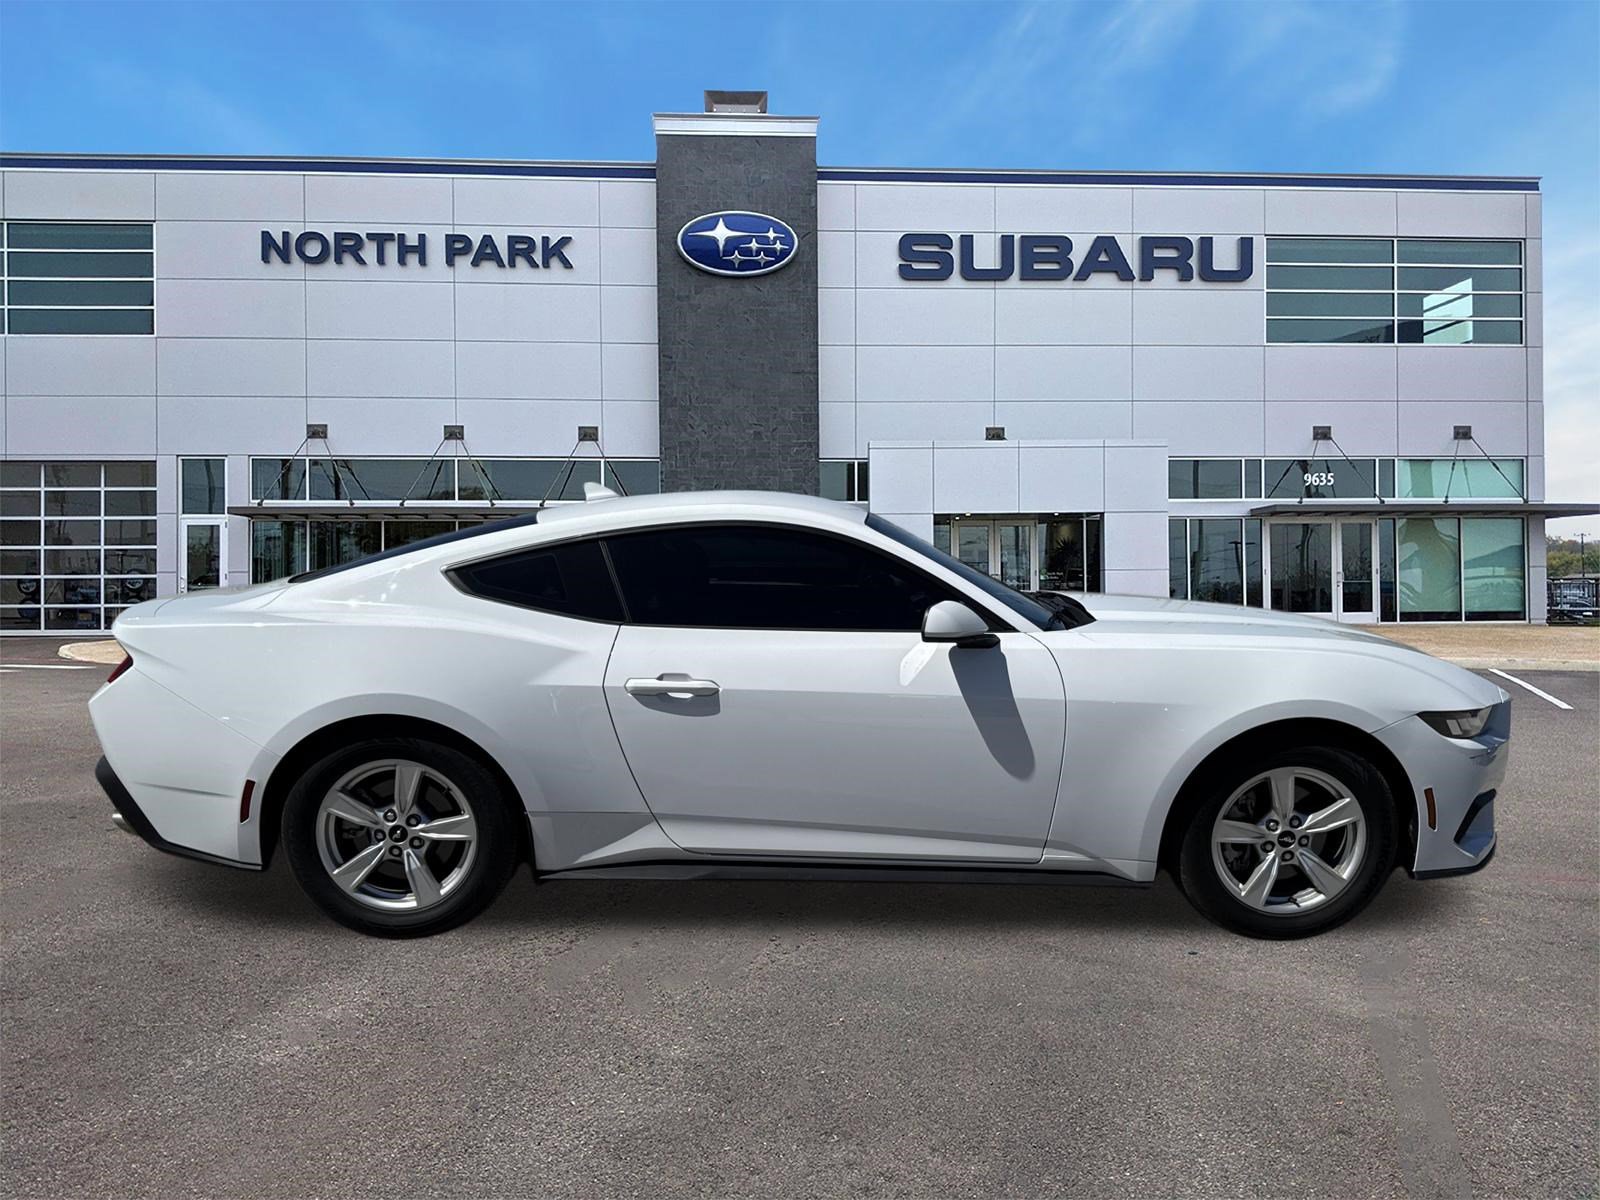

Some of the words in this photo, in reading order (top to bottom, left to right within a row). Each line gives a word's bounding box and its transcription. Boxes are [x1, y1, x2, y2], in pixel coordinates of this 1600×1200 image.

[260, 230, 427, 267] NORTH
[445, 233, 574, 269] PARK
[898, 233, 1254, 282] SUBARU
[1303, 472, 1335, 486] 9635
